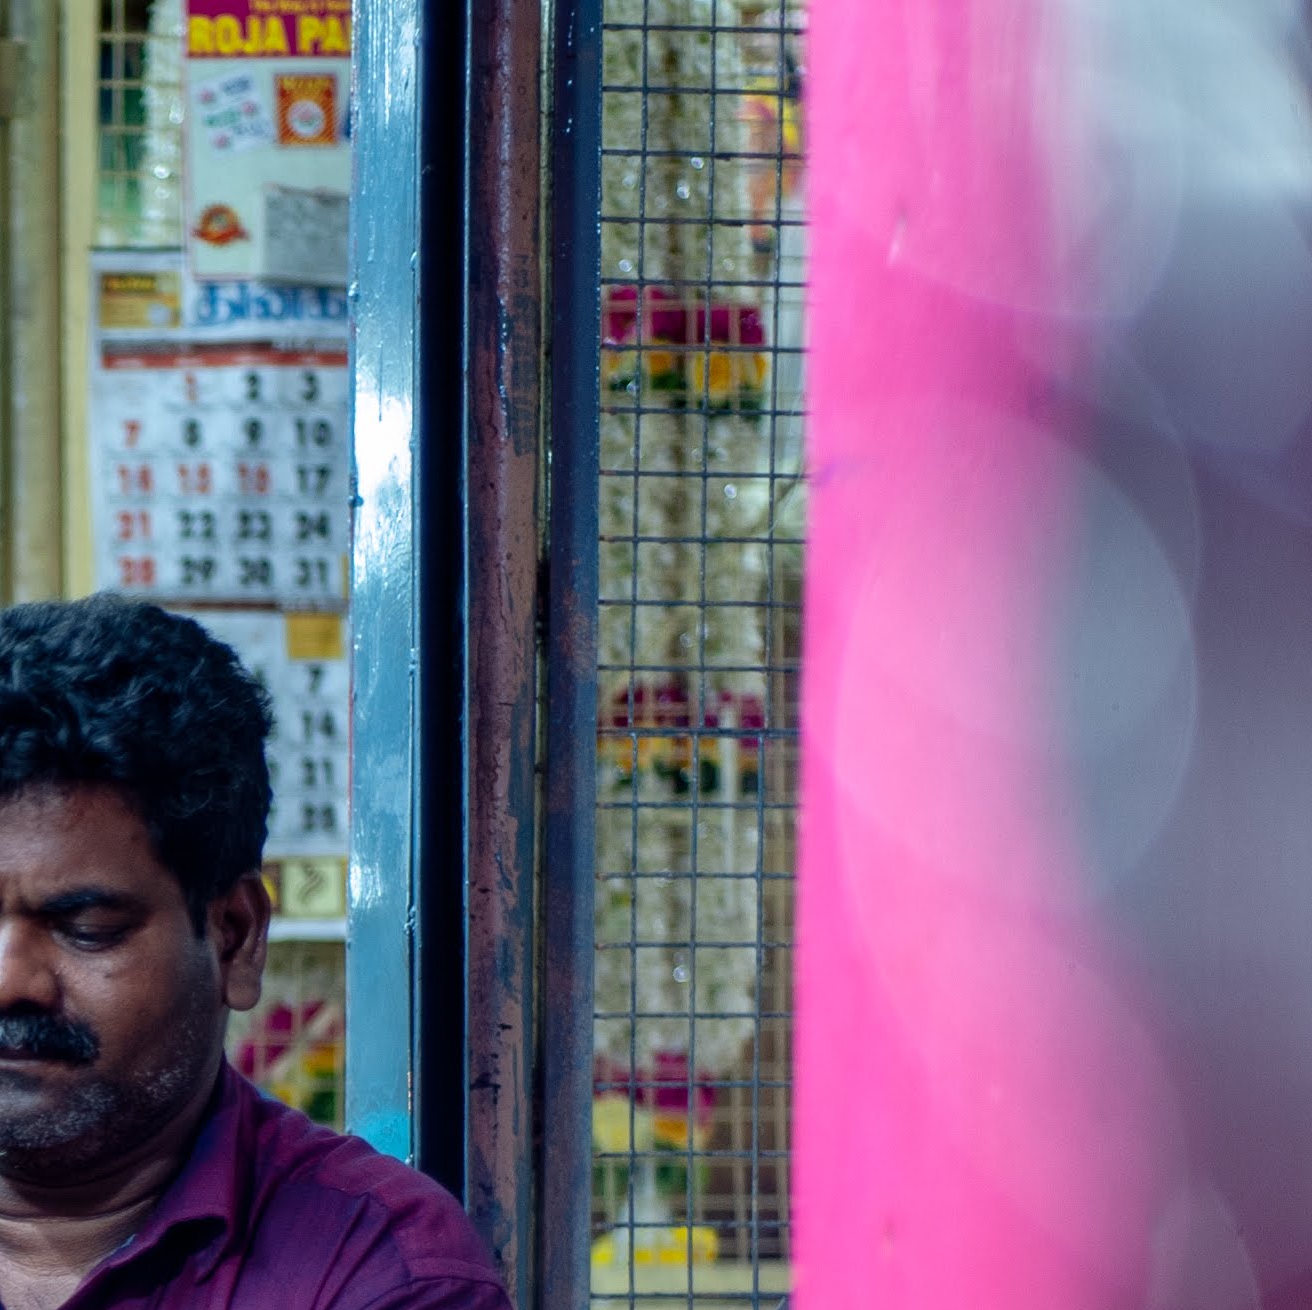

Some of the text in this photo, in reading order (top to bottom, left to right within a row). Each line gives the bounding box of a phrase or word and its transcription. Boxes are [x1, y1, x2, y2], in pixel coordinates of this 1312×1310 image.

[189, 14, 350, 54] ROJA PA
[294, 418, 332, 449] 10
[296, 463, 333, 493] 17
[179, 510, 217, 542] 22
[296, 557, 329, 589] 31
